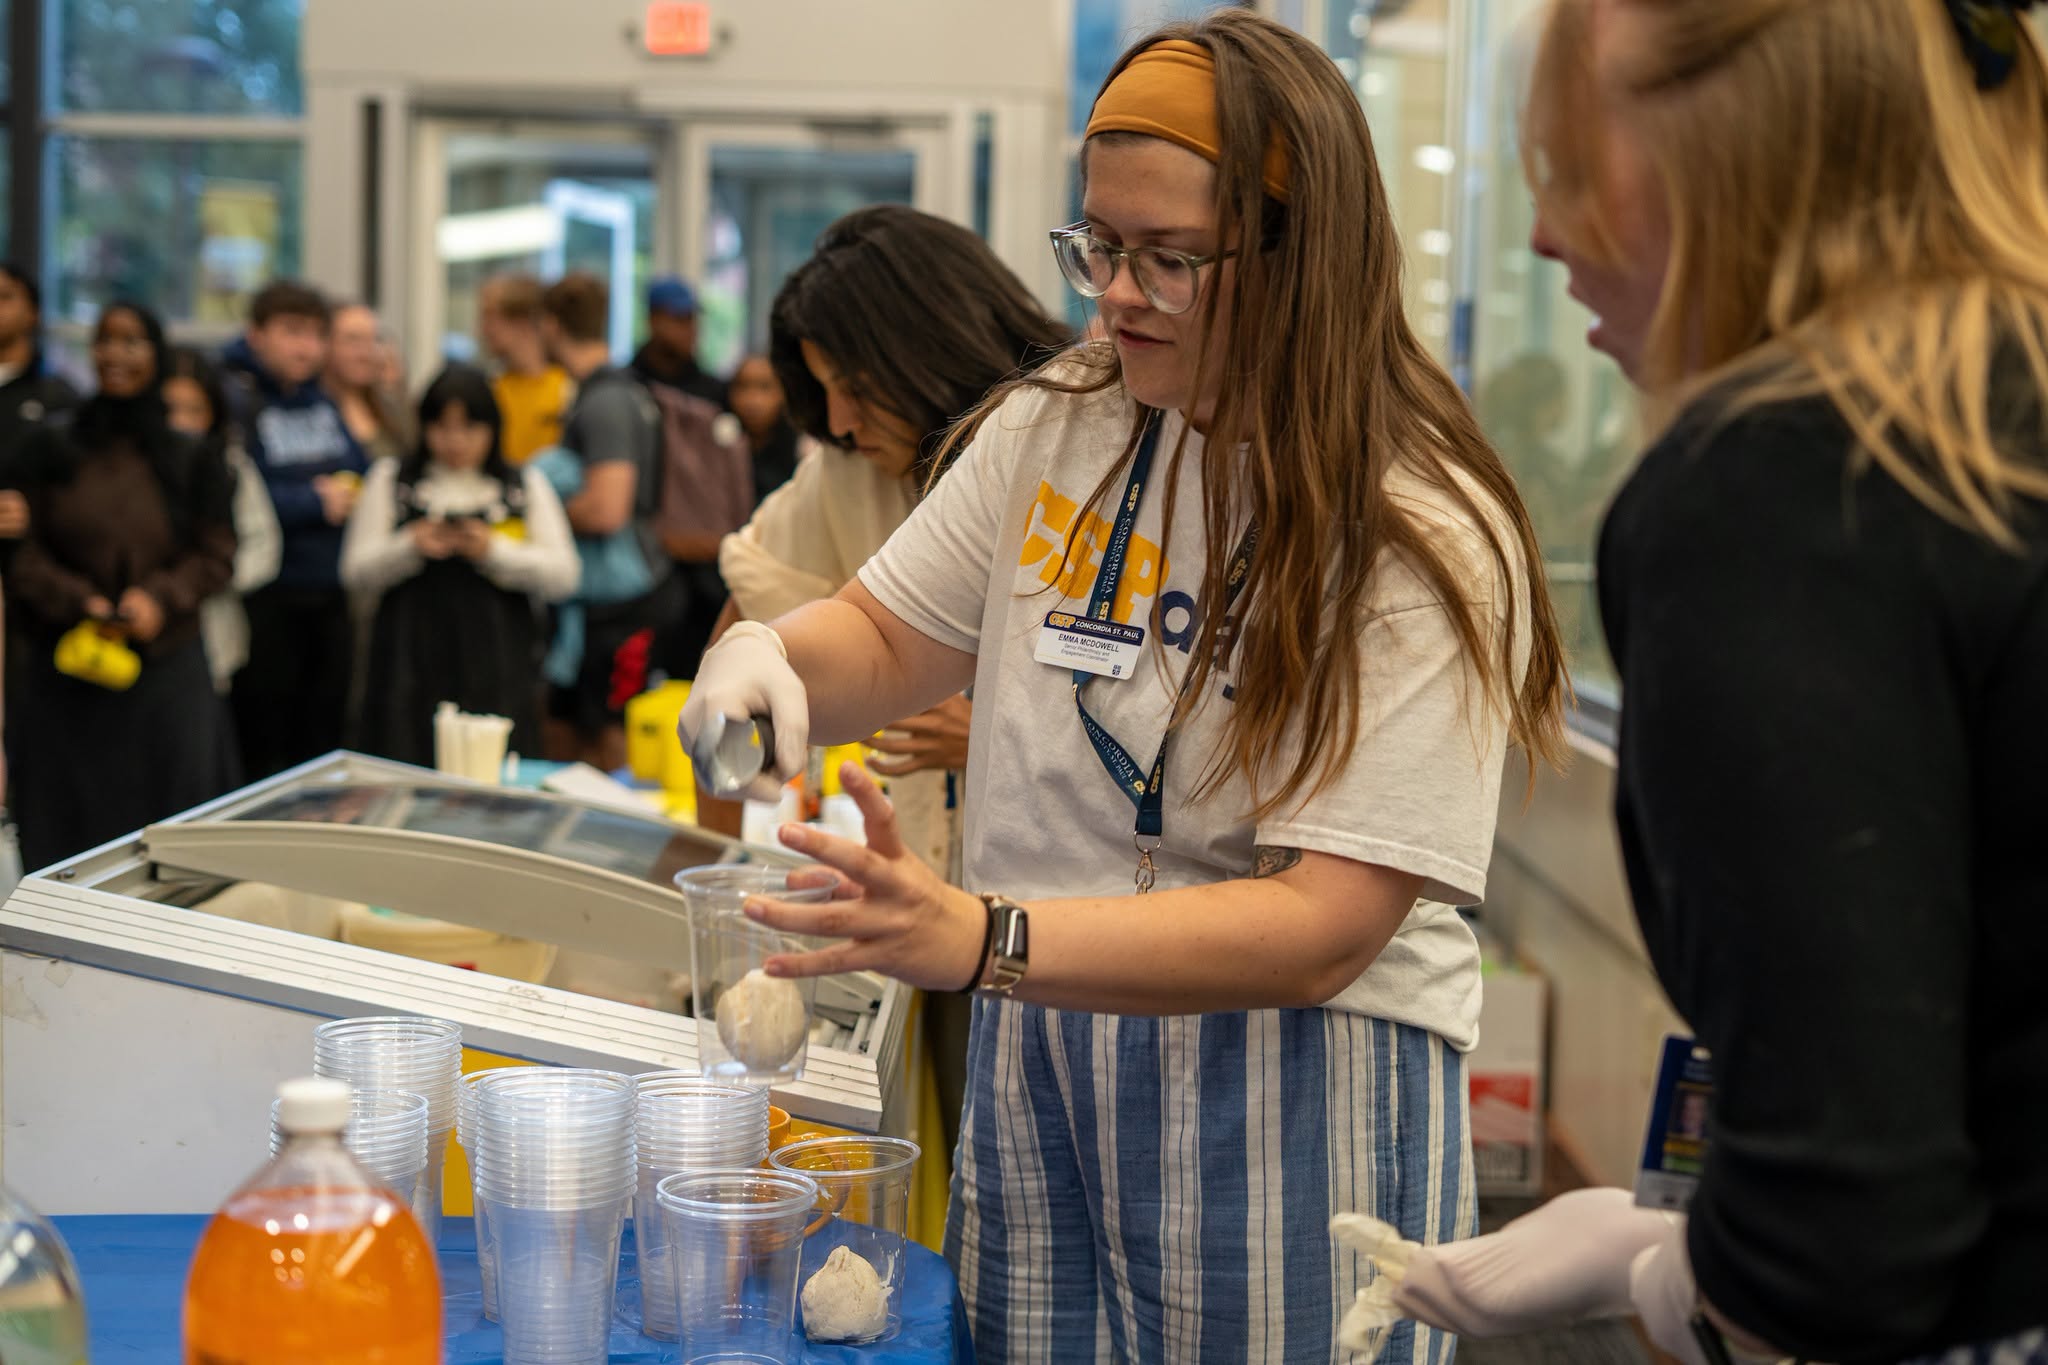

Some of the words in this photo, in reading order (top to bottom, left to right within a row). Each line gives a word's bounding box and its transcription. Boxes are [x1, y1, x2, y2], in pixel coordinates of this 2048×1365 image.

[1126, 482, 1141, 512] CSP
[1019, 480, 1170, 625] CSP
[1104, 517, 1132, 595] CONCORDIA
[1225, 557, 1249, 586] CSP
[1049, 612, 1076, 629] CSP
[1075, 620, 1112, 633] CONCORDIA
[1112, 628, 1122, 636] ST.
[1123, 630, 1139, 639] PAUL
[1058, 633, 1079, 645] EMMA
[1080, 638, 1119, 653] MCDOWELL
[1082, 715, 1134, 778] CONCORDIA
